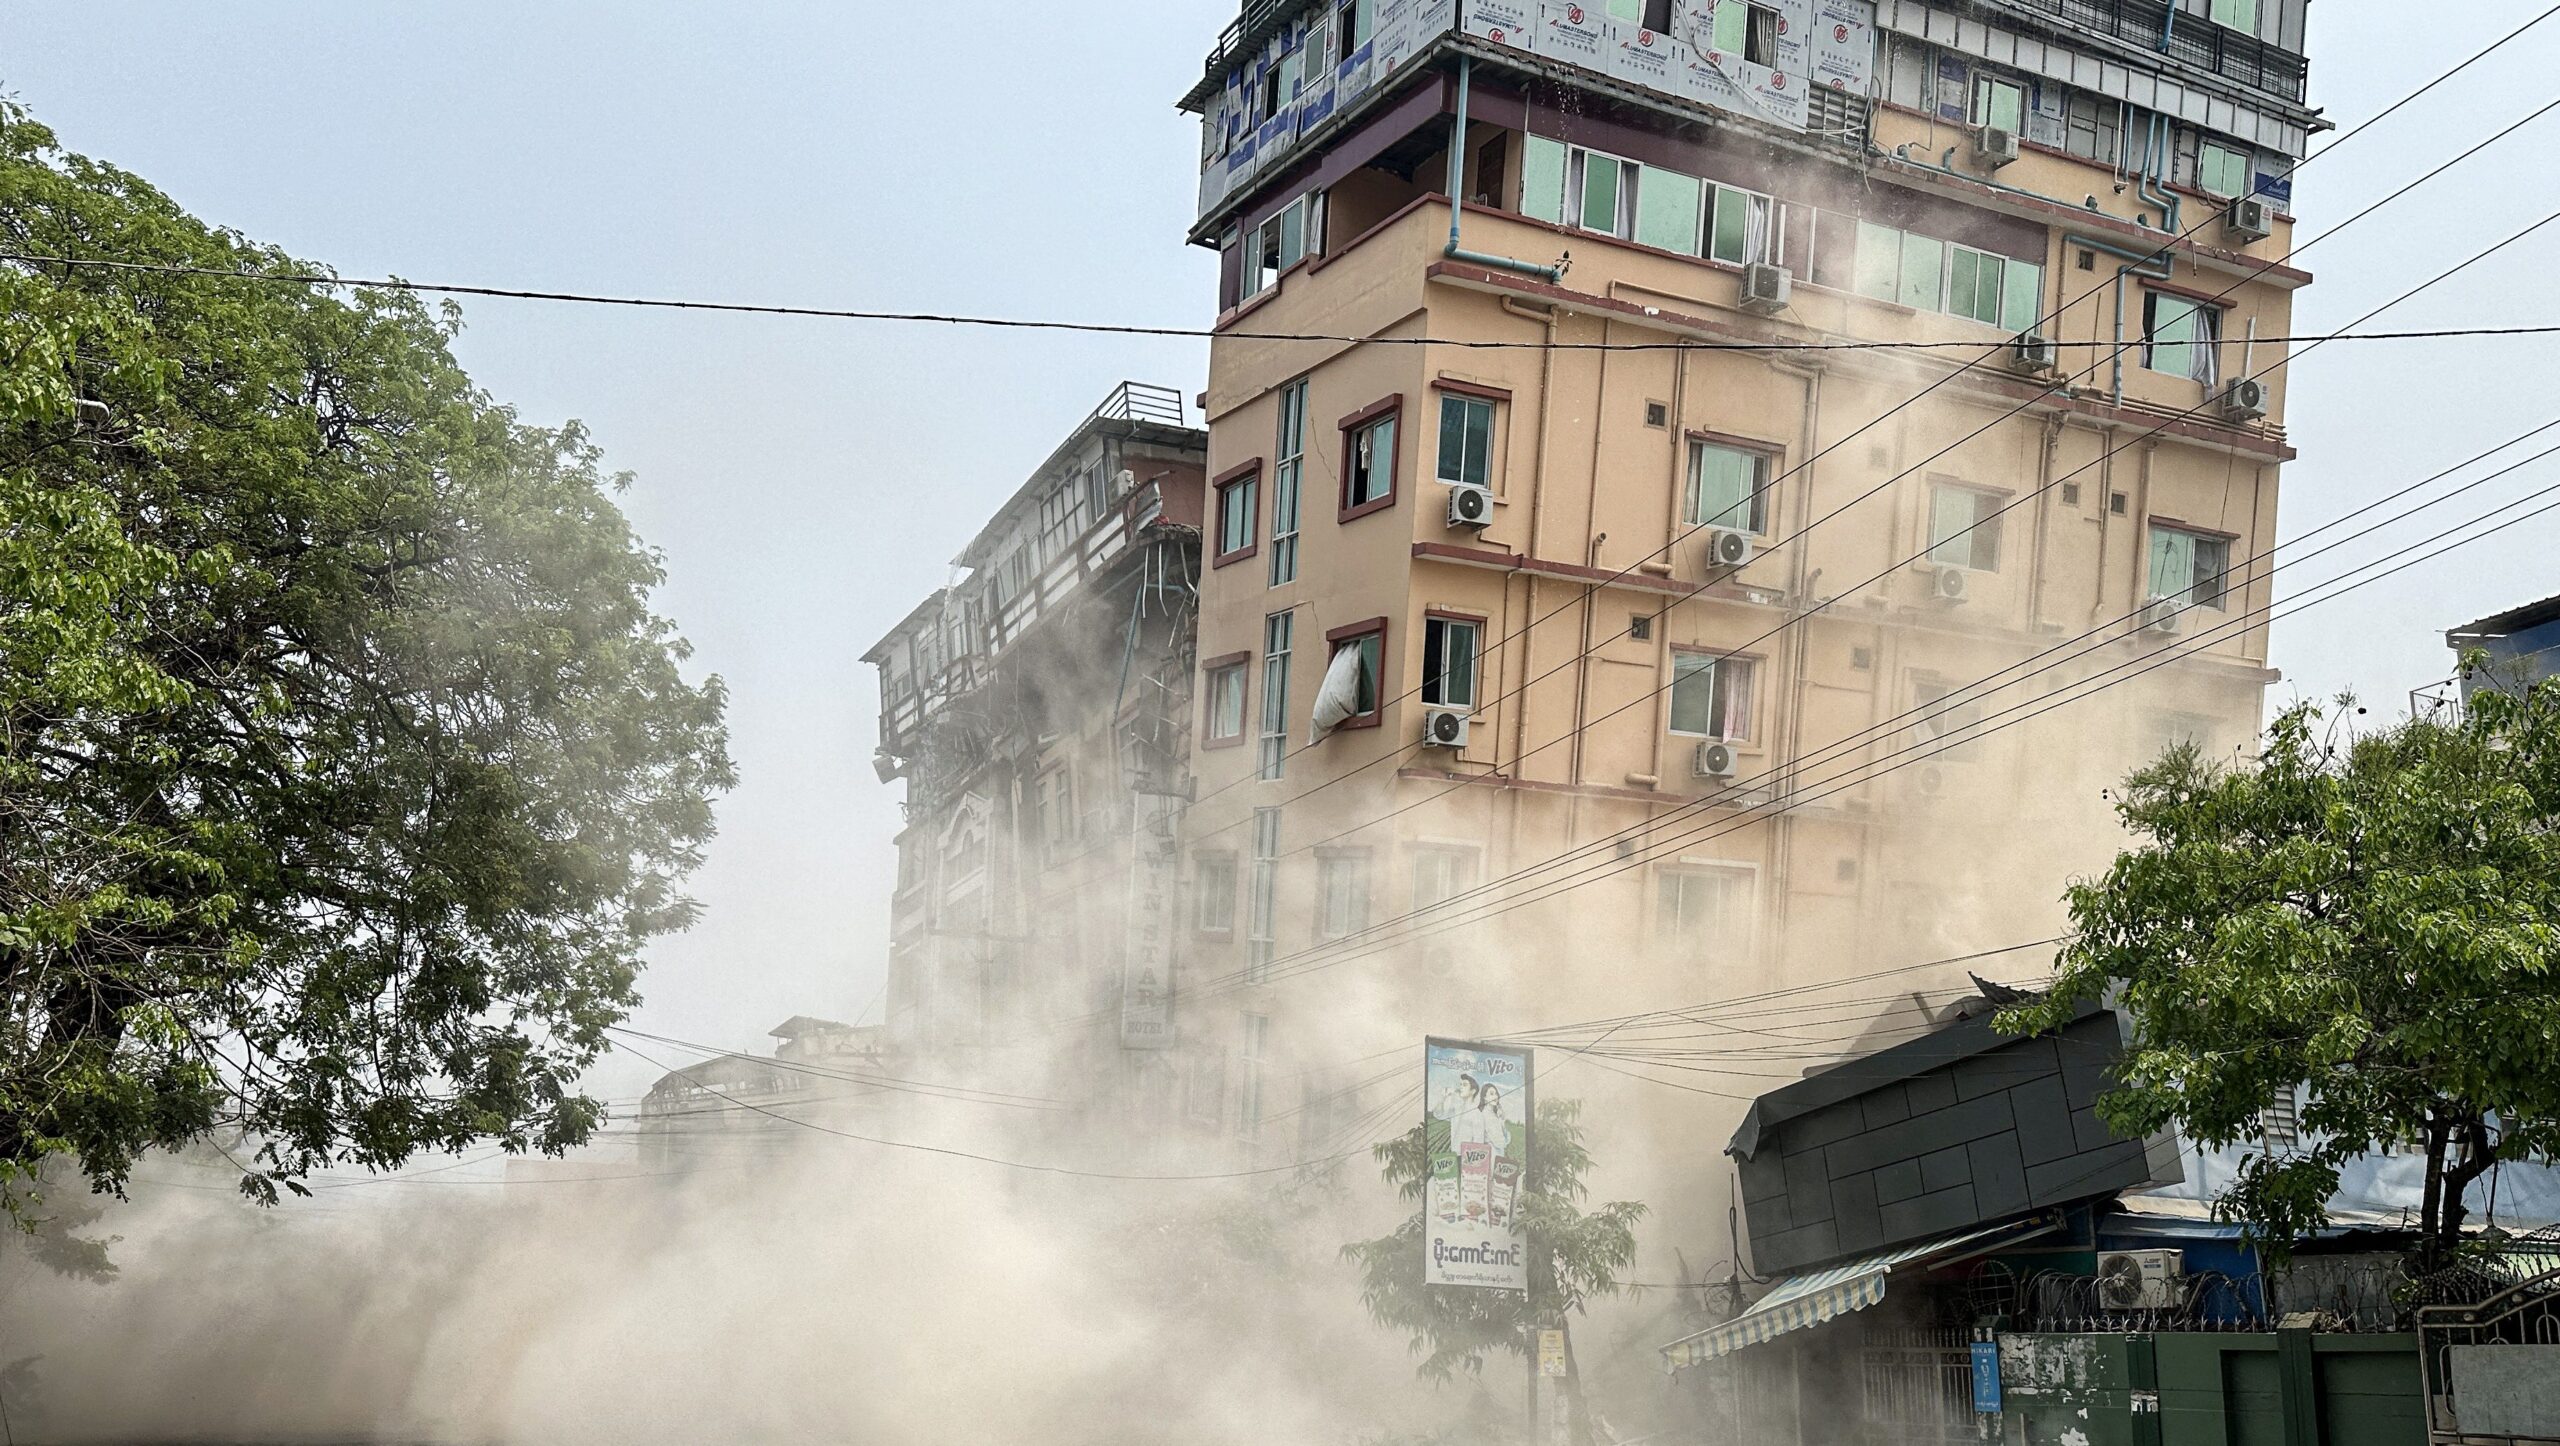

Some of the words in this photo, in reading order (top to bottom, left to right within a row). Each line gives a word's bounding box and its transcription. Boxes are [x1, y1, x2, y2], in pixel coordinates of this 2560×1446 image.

[1127, 1020, 1163, 1035] HOTEL
[1487, 1059, 1514, 1076] Vito
[1465, 1151, 1486, 1163] Vito
[1436, 1160, 1453, 1170] Vito
